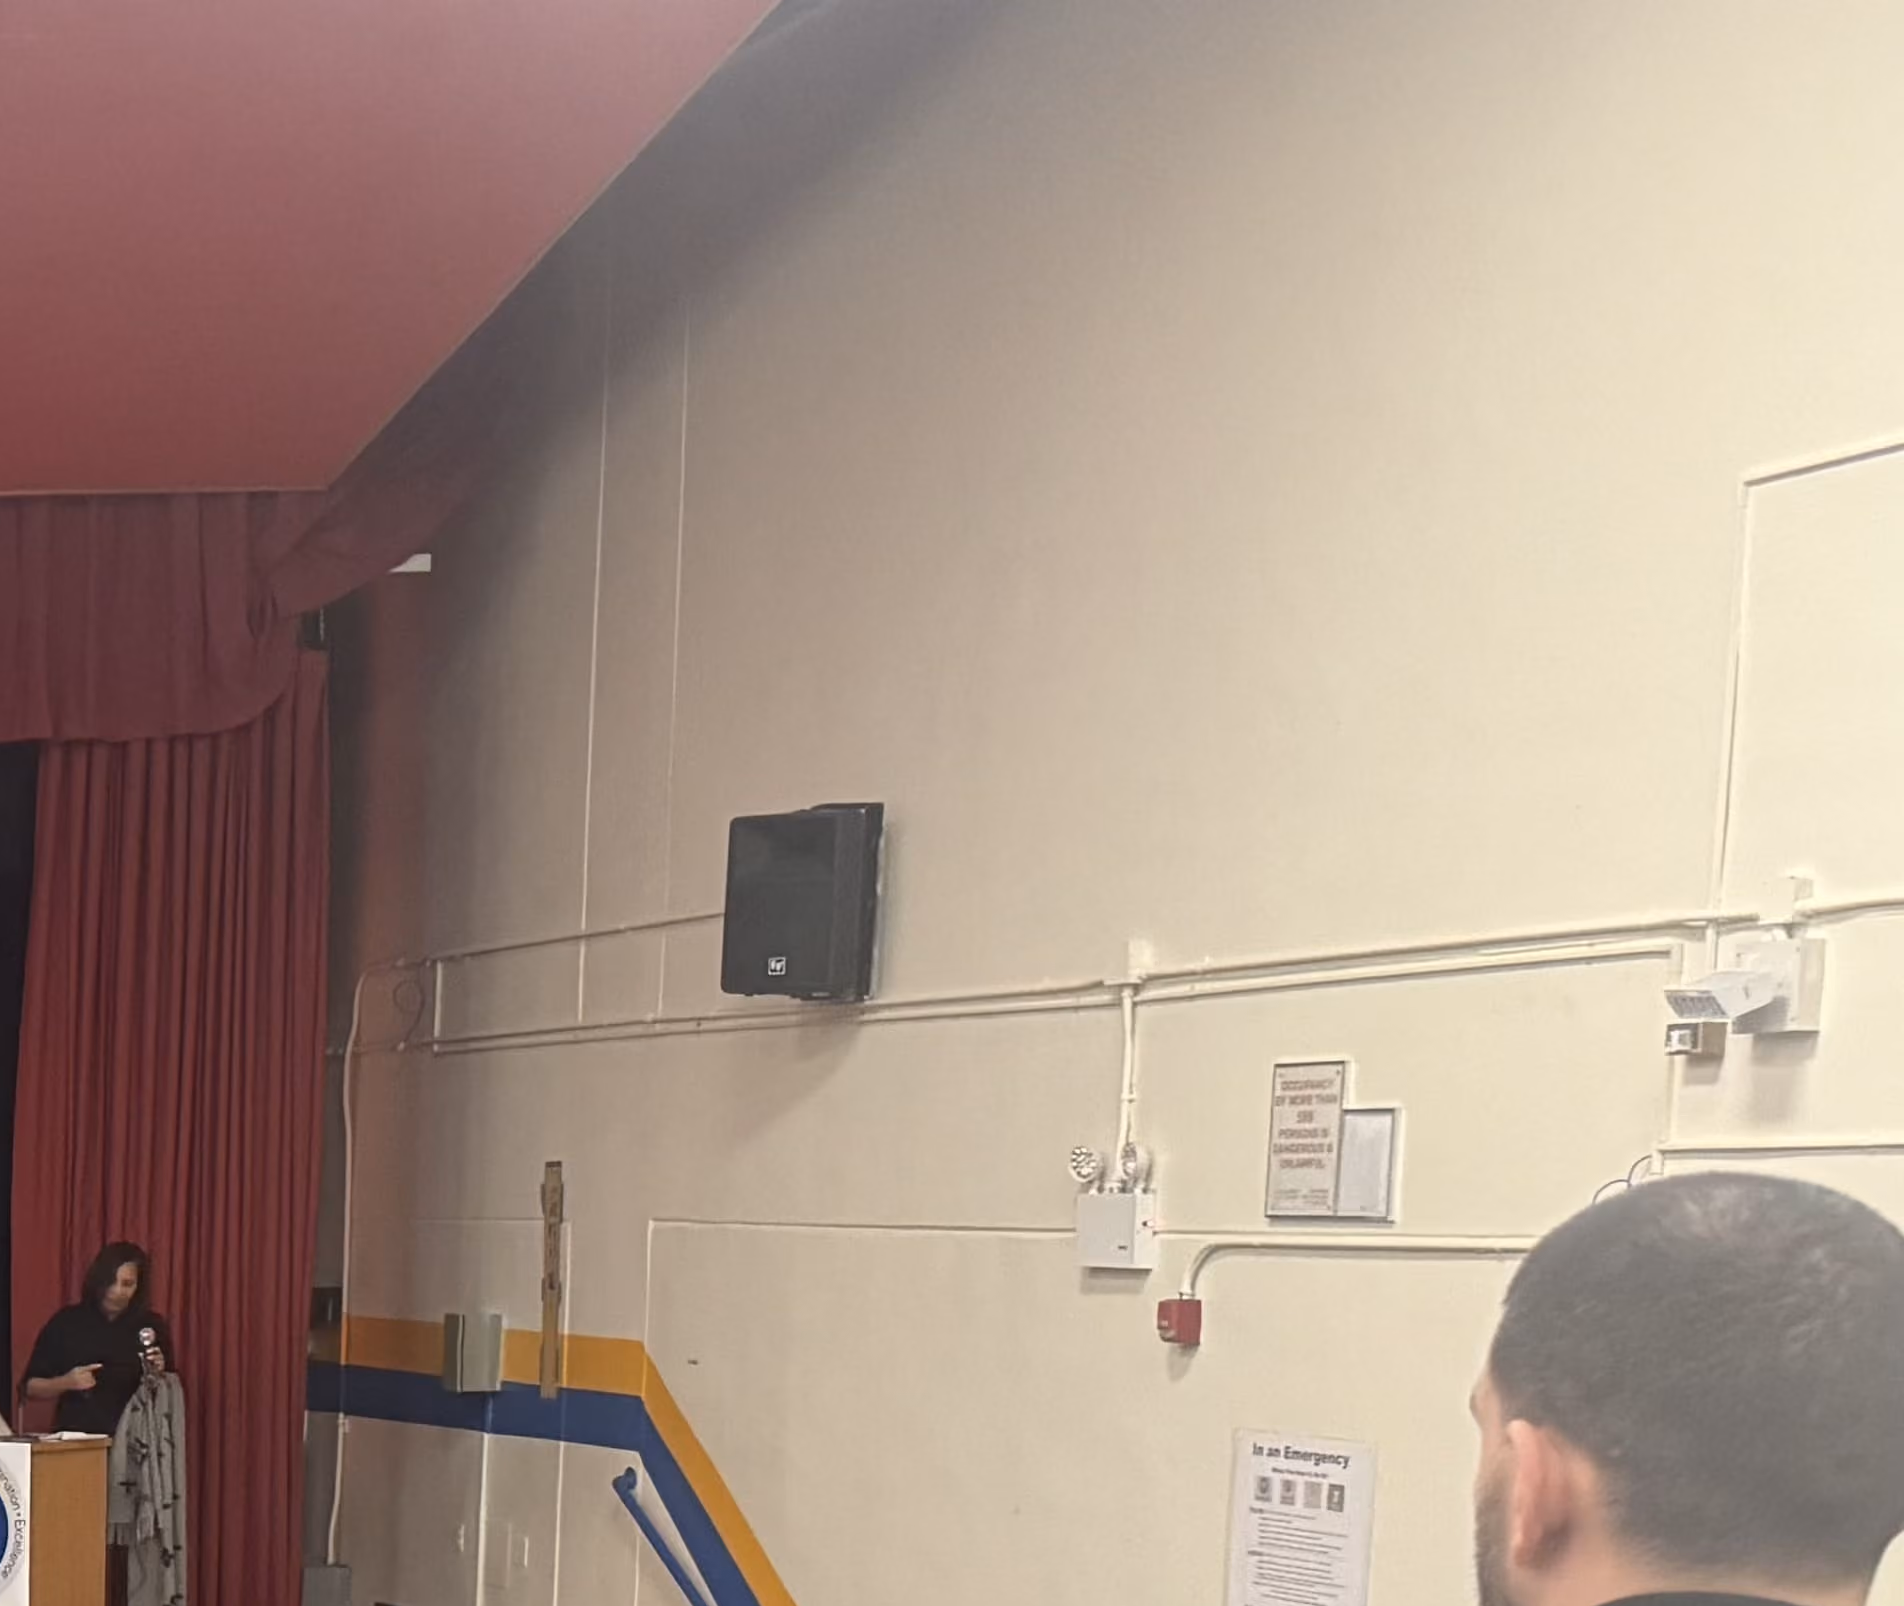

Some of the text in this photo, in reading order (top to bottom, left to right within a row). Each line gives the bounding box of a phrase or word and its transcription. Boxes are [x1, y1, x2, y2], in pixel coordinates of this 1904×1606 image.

[1252, 1442, 1350, 1469] In an Emergency
